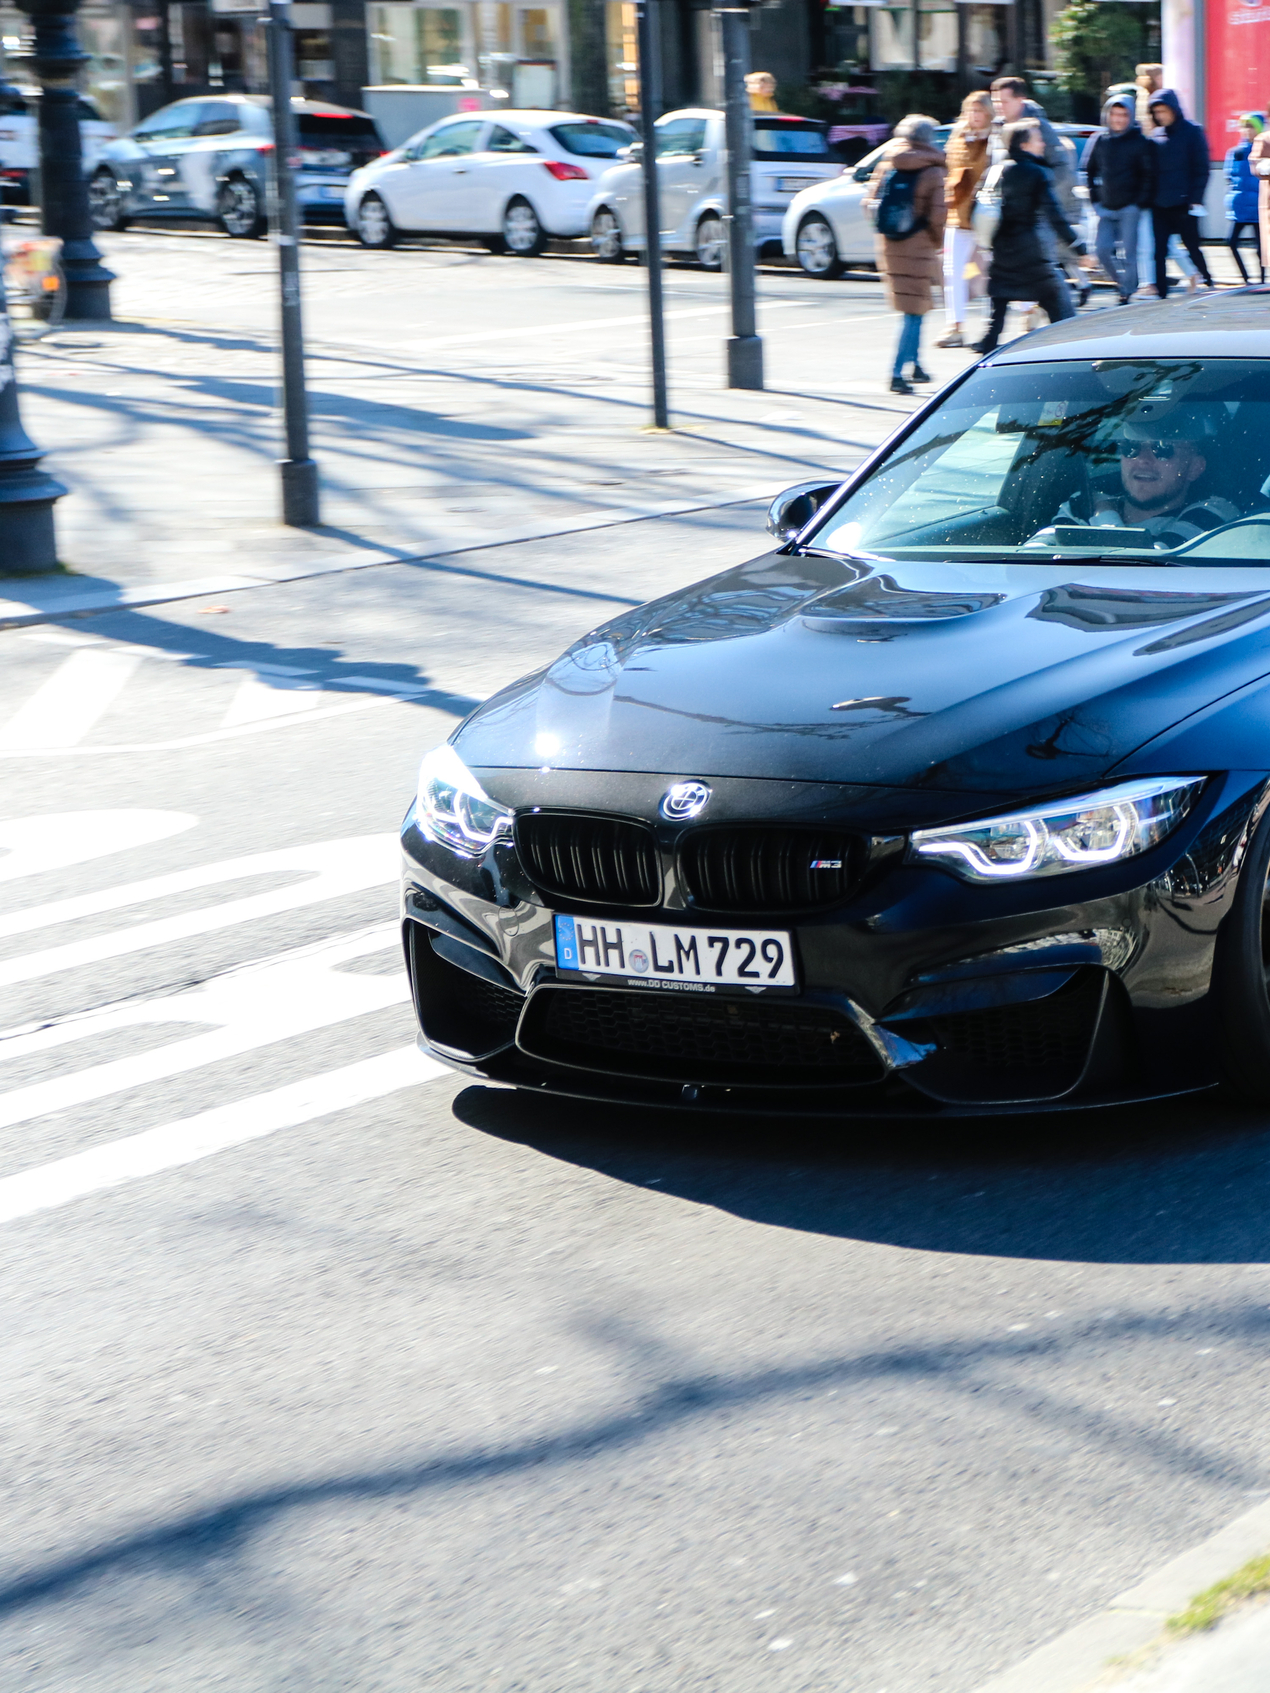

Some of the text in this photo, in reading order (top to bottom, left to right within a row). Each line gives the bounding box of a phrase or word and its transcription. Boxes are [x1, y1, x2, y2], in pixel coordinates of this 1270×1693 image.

[814, 860, 842, 869] M3
[564, 947, 572, 960] D
[576, 923, 784, 979] HH LM 729
